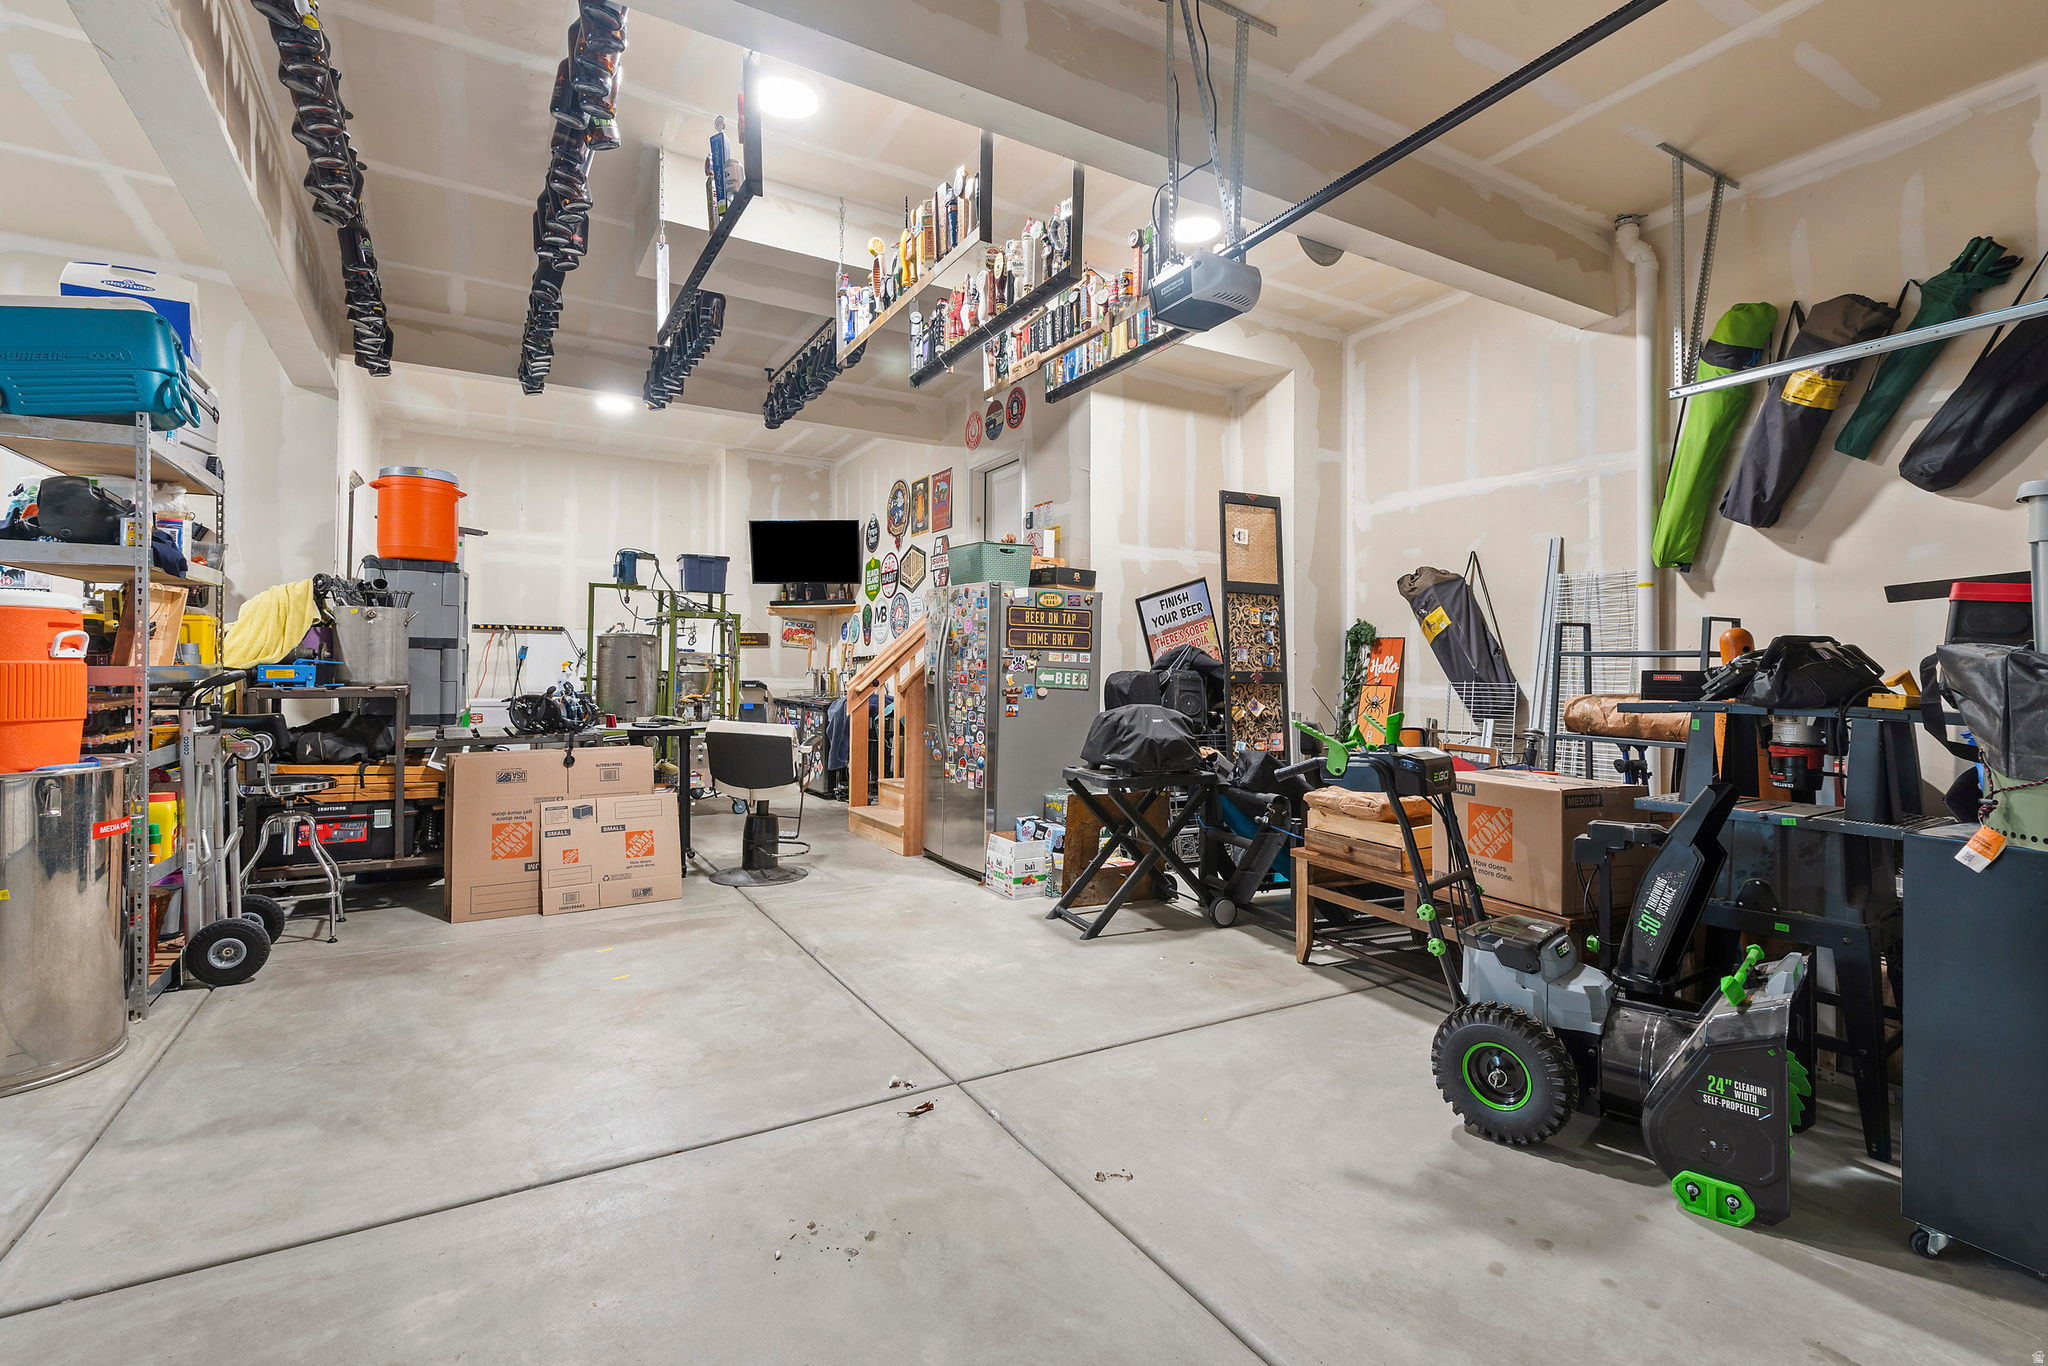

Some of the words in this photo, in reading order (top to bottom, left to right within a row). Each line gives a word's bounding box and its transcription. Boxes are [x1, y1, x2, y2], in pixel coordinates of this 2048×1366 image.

[1159, 591, 1190, 610] FINISH
[1025, 611, 1045, 624] BEER
[1048, 612, 1059, 624] ON
[1062, 613, 1076, 625] TAP
[1151, 610, 1178, 628] YOUR
[1180, 602, 1204, 619] BEER
[782, 628, 815, 642] Beer
[1026, 632, 1049, 645] HOME
[1052, 633, 1075, 646] BREW
[1155, 630, 1184, 648] THERE'S
[1185, 622, 1209, 638] SOBER
[1370, 655, 1400, 678] Hello
[1055, 672, 1087, 686] BEER
[512, 771, 526, 780] USA
[1434, 770, 1449, 782] EGO
[1567, 796, 1600, 807] MEDIUM
[100, 822, 120, 834] MEDIA
[1472, 810, 1490, 830] THE
[492, 822, 517, 847] DEPOT
[628, 834, 640, 845] THE
[1467, 807, 1514, 856] HOME
[492, 822, 532, 860] HOME
[512, 840, 529, 855] THE
[626, 830, 654, 858] HOME
[638, 840, 654, 857] DEPOT
[1484, 828, 1513, 858] DEPOT
[1024, 862, 1036, 870] bai
[1473, 859, 1487, 868] How
[1488, 862, 1507, 872] doers
[1478, 869, 1494, 877] more
[1496, 871, 1514, 881] done.
[1645, 876, 1668, 911] THROWING
[1656, 885, 1677, 917] DISTANCE
[1707, 1074, 1732, 1095] 24"
[1734, 1081, 1767, 1097] CLEARING
[1734, 1090, 1757, 1104] WIDTH
[1702, 1094, 1760, 1117] SELF-PROPELLED
